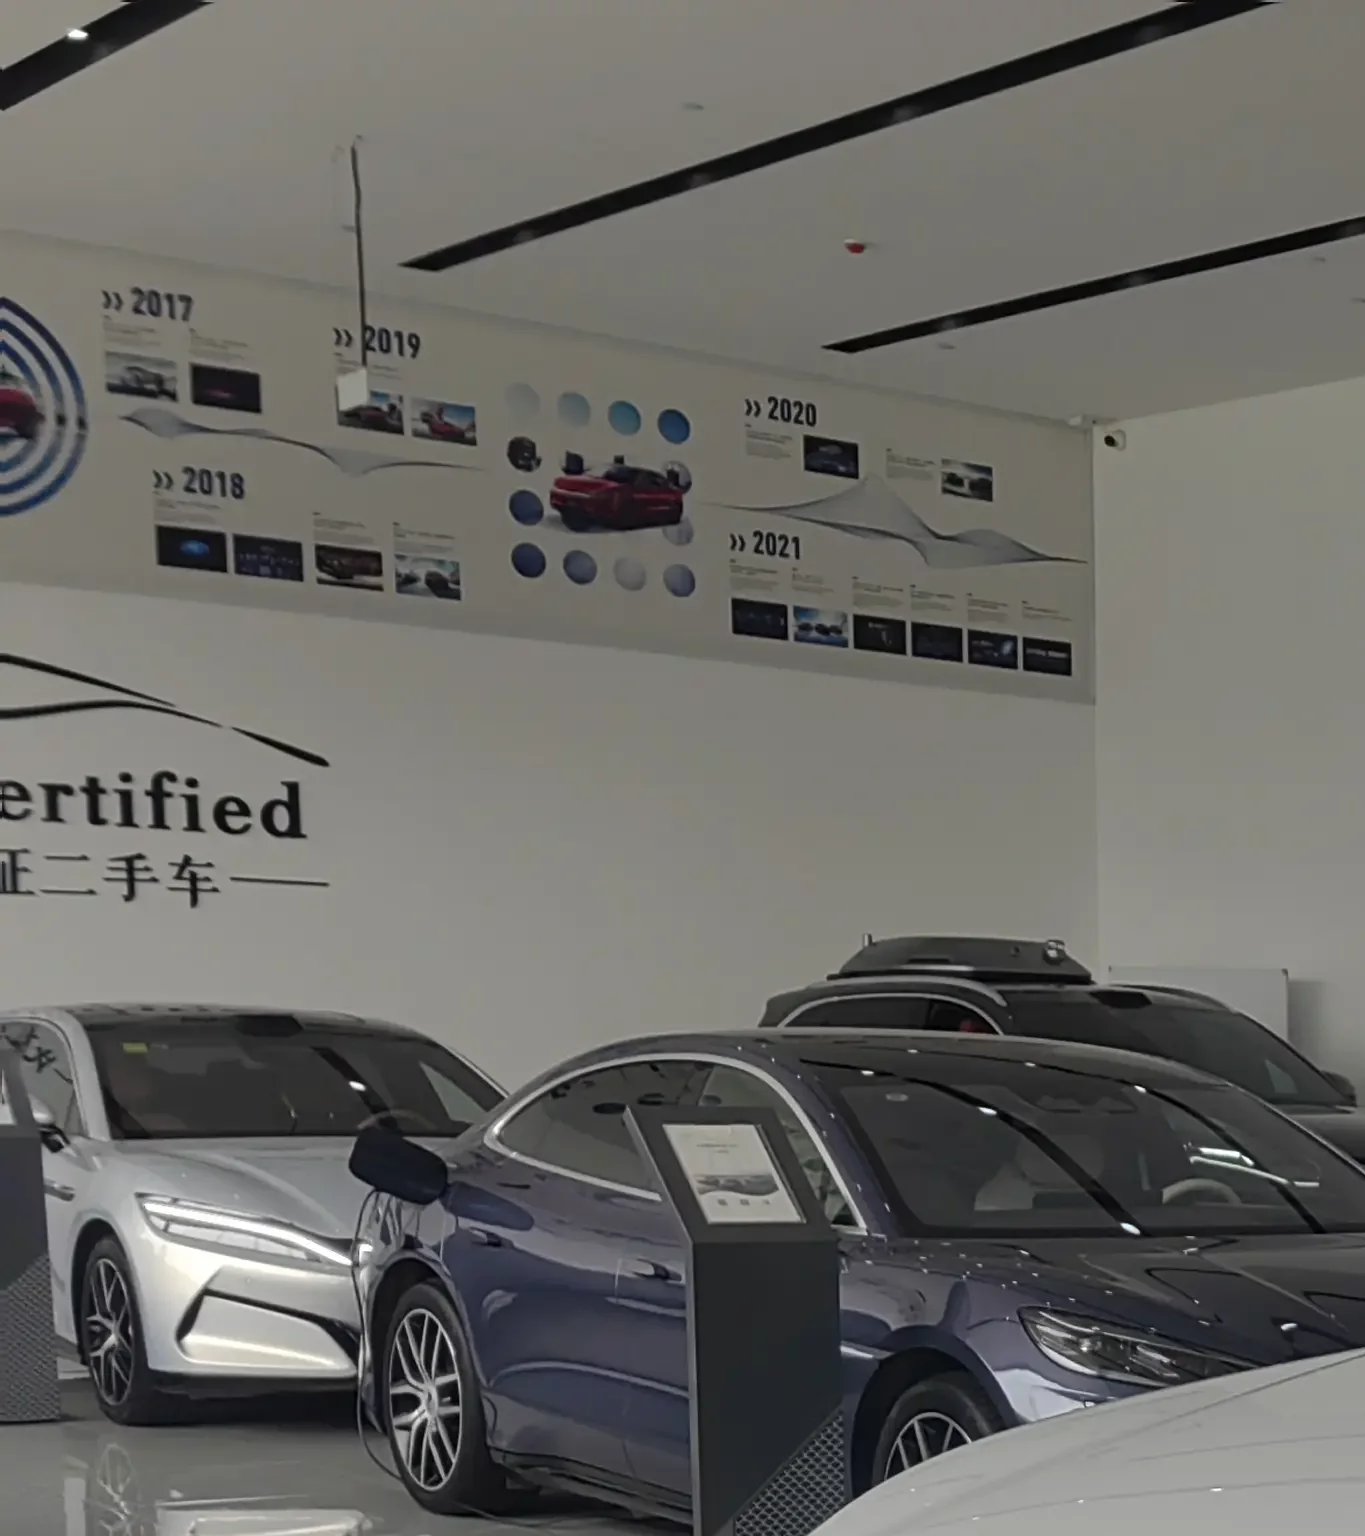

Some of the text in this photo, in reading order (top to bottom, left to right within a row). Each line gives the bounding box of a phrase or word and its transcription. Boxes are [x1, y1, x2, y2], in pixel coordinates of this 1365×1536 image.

[130, 286, 194, 322] 2017
[362, 324, 421, 359] 2019
[767, 396, 817, 427] 2020
[182, 466, 245, 500] 2018
[753, 530, 800, 560] 2021
